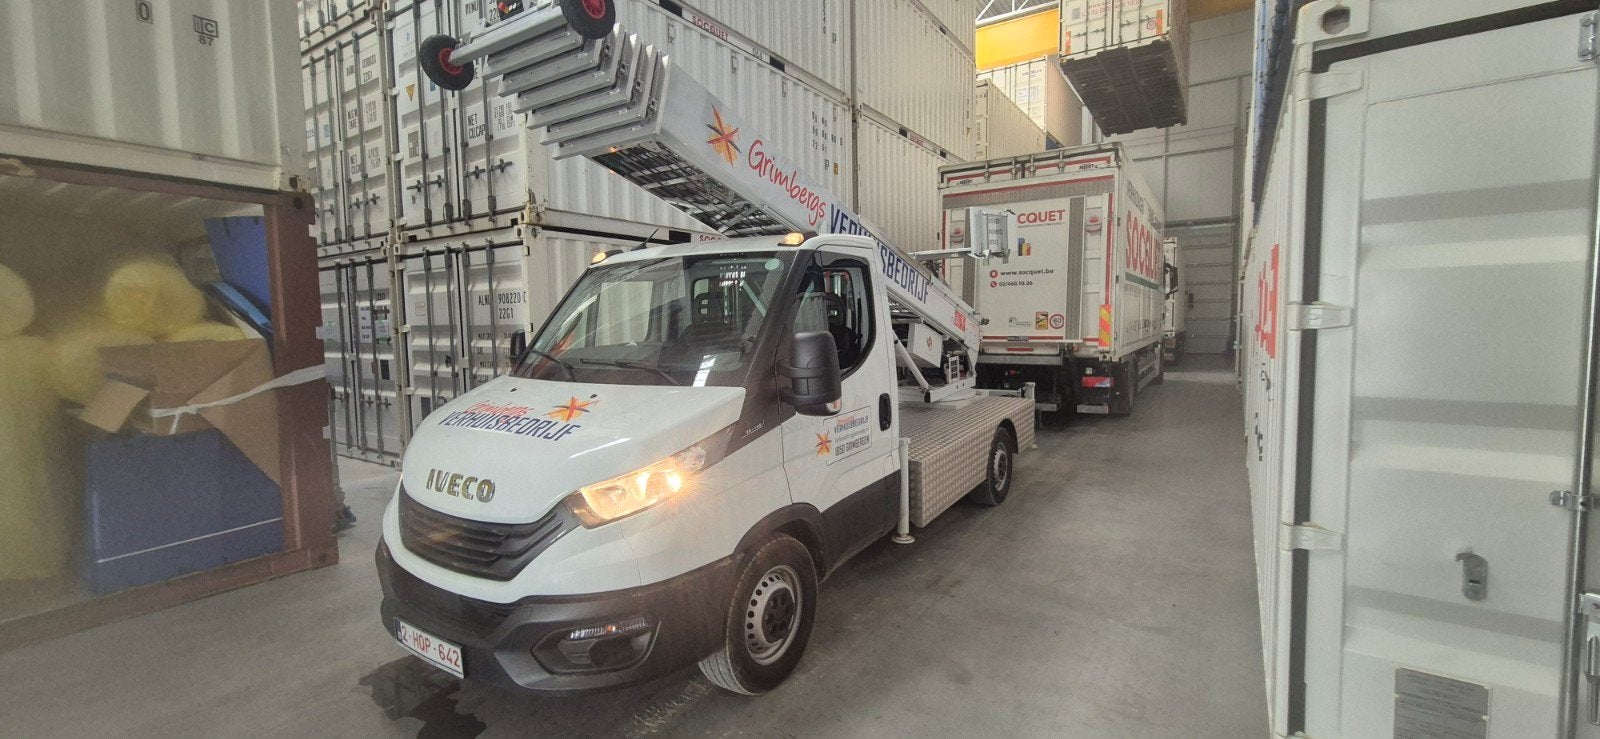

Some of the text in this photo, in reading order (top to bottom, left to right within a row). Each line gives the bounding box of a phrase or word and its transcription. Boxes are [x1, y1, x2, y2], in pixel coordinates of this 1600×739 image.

[692, 15, 729, 42] SOCQUET
[748, 139, 827, 226] Grimbergs
[1017, 209, 1066, 224] CQUET
[1000, 268, 1055, 277] www.socquet.be
[438, 411, 582, 442] VERHUISBEDRIJF
[426, 468, 496, 503] IVECO
